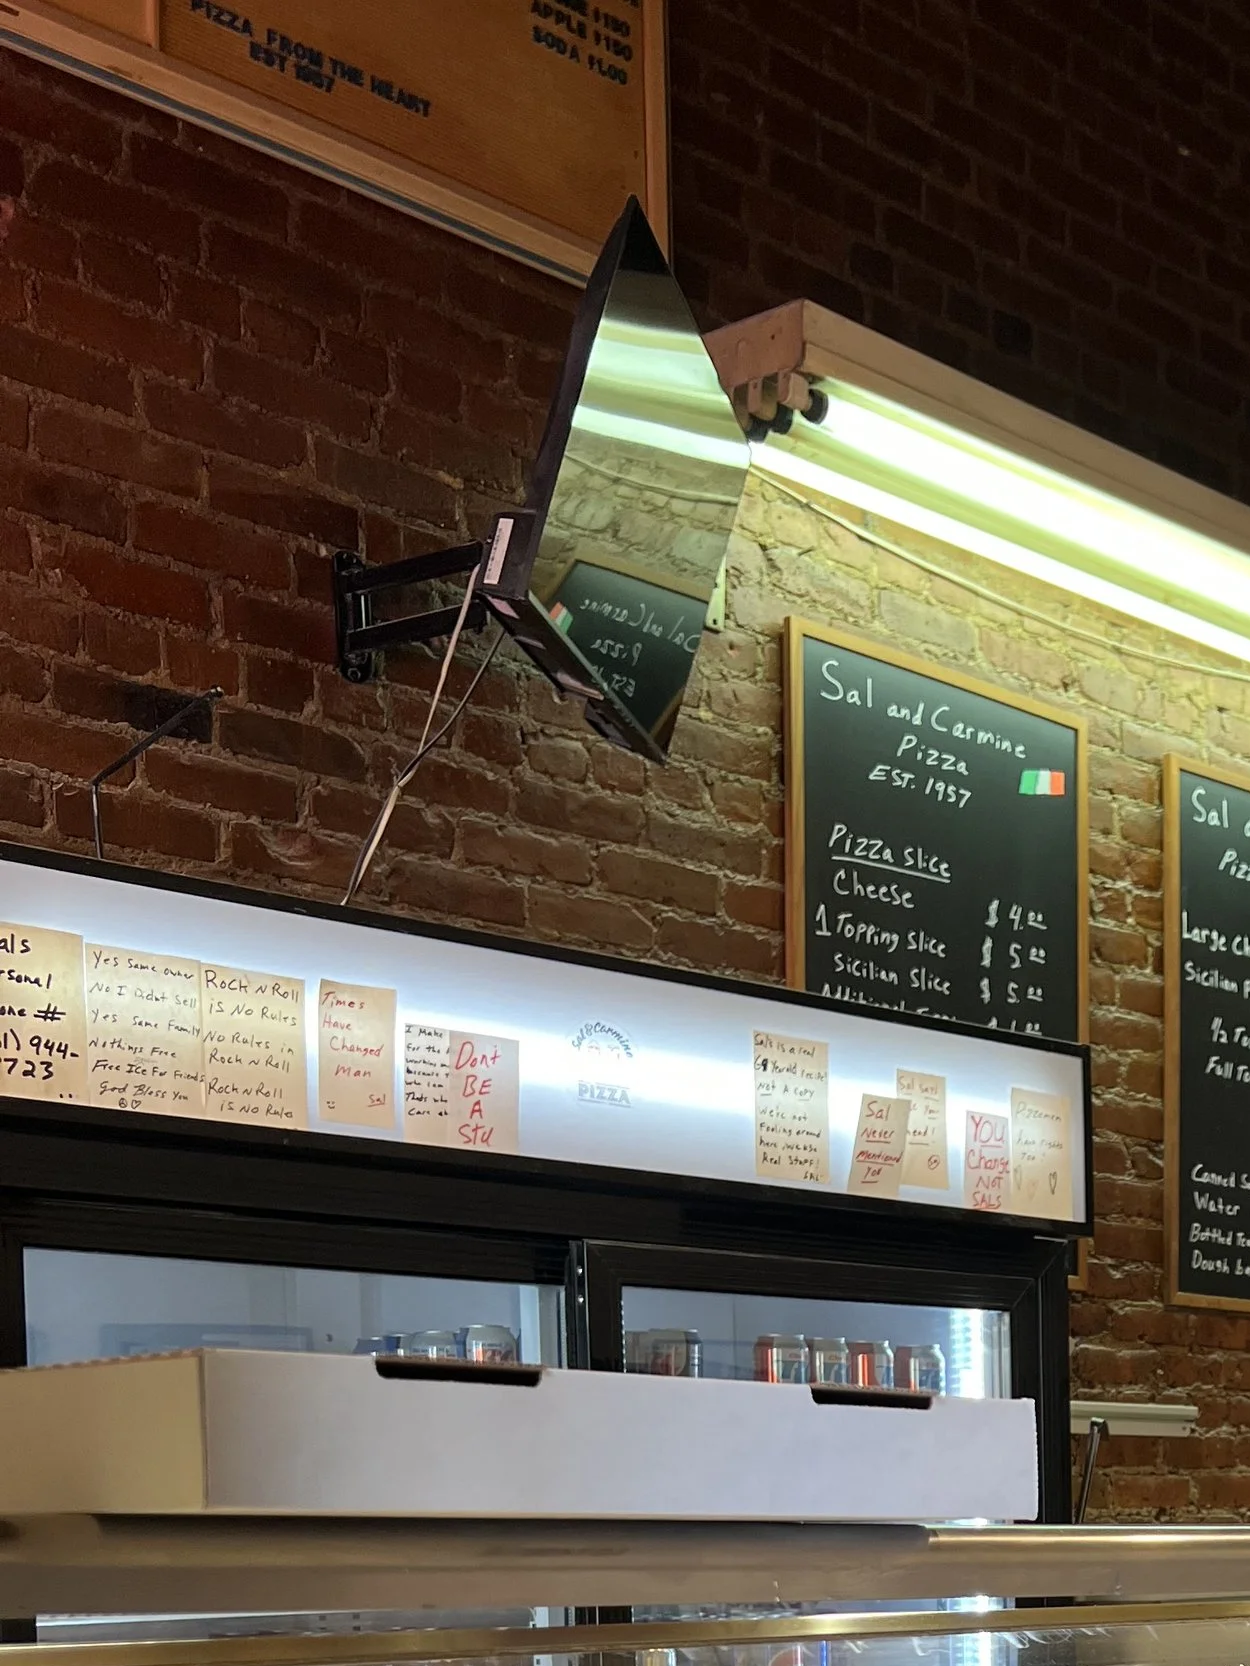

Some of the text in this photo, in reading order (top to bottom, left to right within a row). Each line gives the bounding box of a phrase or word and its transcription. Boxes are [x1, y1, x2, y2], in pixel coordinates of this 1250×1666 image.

[267, 28, 324, 69] FROM
[329, 56, 365, 86] THE
[820, 660, 1027, 759] Sal and Carmine
[896, 735, 969, 775] Pizza
[924, 777, 971, 809] 1957
[1191, 785, 1229, 828] Sal
[828, 824, 951, 878] Pizza Slice
[832, 869, 915, 909] Cheese
[836, 912, 900, 953] Topping
[907, 931, 948, 958] Slice
[1182, 909, 1227, 952] Large
[93, 951, 118, 968] Yes
[128, 959, 156, 973] Same
[833, 953, 899, 985] Sicilian
[910, 967, 951, 996] Slice
[1184, 960, 1238, 993] Sicilian
[89, 982, 110, 993] No
[118, 986, 127, 995] I
[175, 995, 196, 1008] Sell
[272, 983, 298, 1003] Roll
[322, 991, 365, 1009] Times
[92, 1009, 200, 1037] Yes Same Family
[231, 1004, 253, 1016] No
[261, 1006, 296, 1026] Rules
[323, 1013, 351, 1030] Have
[203, 1031, 225, 1042] No
[232, 1032, 270, 1049] Rules
[330, 1036, 384, 1057] Changed
[151, 1047, 176, 1058] Free
[266, 1055, 289, 1073] Roll
[92, 1060, 120, 1072] Free
[335, 1065, 371, 1077] Man
[1205, 1056, 1233, 1079] Full
[256, 1082, 282, 1098] Roll
[463, 1075, 492, 1097] BE
[578, 1083, 631, 1104] PIZZA
[240, 1104, 259, 1114] No
[470, 1100, 483, 1119] A
[866, 1100, 891, 1120] Sal
[861, 1128, 895, 1139] Never
[971, 1115, 1005, 1143] YOU
[1191, 1164, 1235, 1189] Canned
[1193, 1191, 1240, 1215] Water
[1189, 1223, 1232, 1246] Bottled
[1192, 1250, 1230, 1274] Dough
